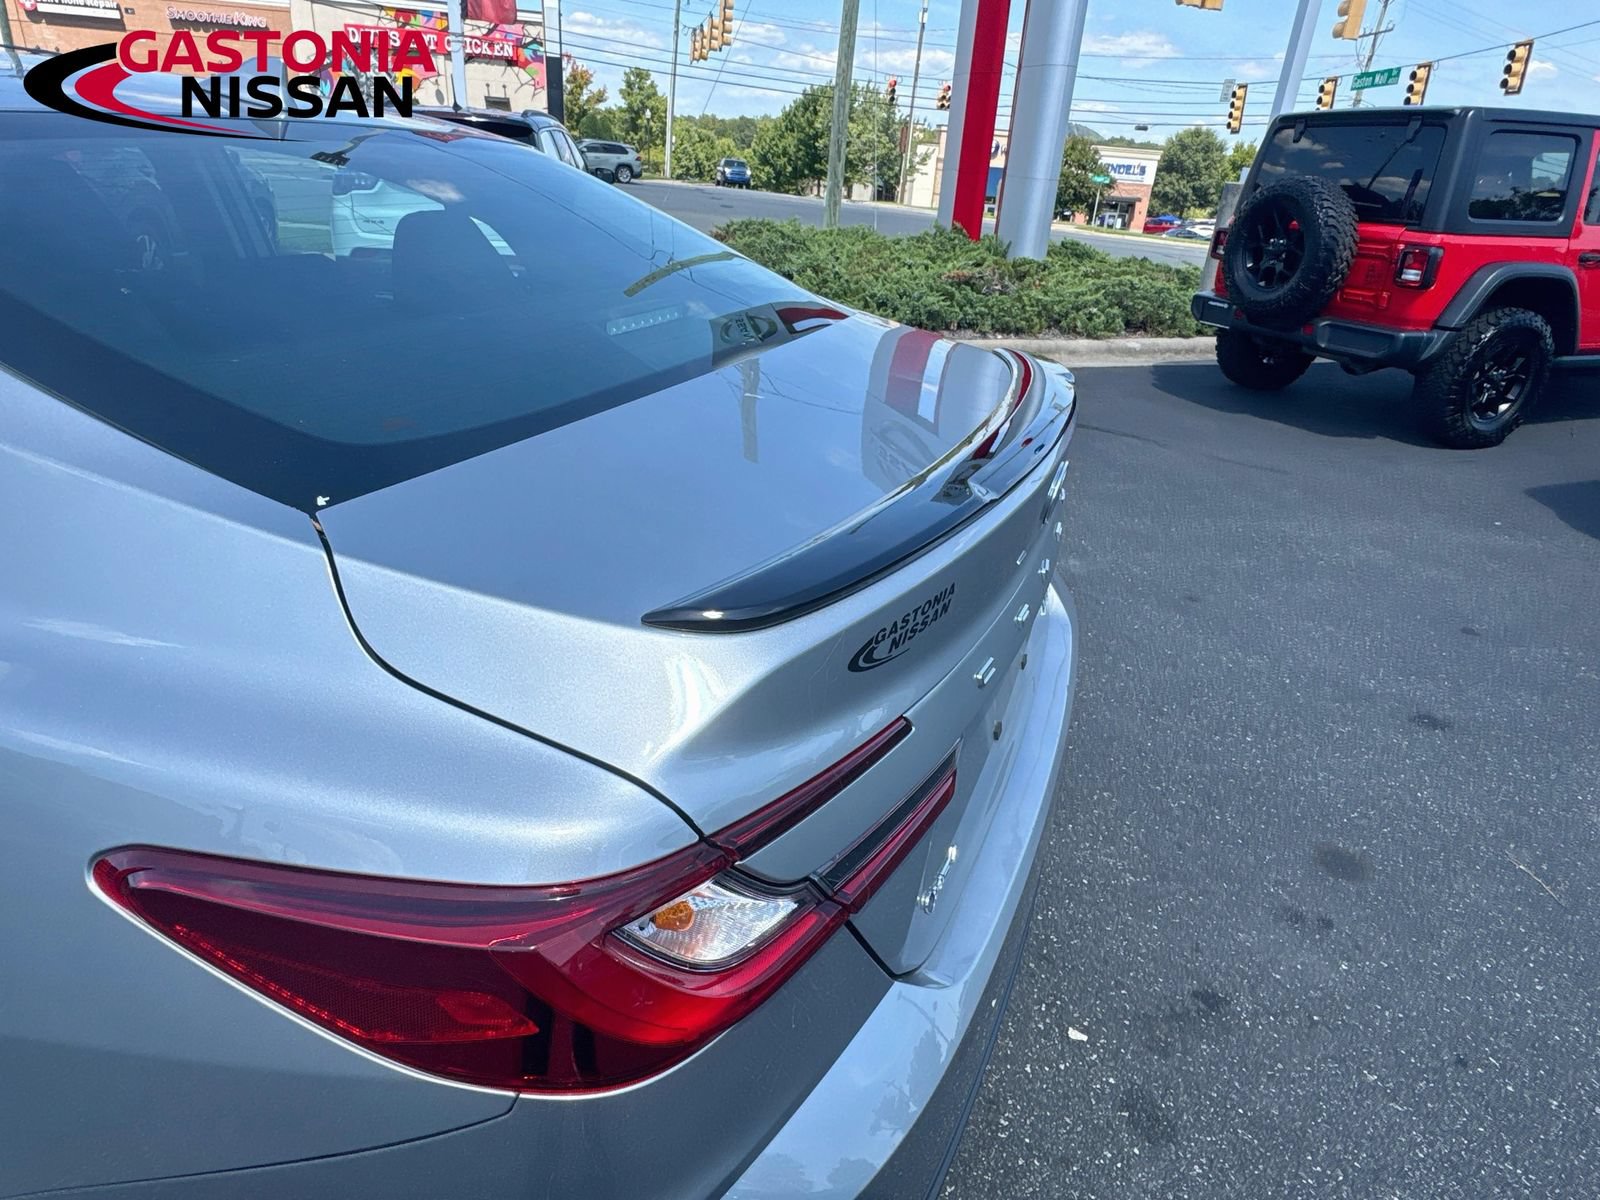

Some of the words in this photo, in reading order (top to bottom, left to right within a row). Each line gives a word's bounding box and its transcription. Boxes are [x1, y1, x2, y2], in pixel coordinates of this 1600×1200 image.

[167, 6, 233, 25] SMOOTHIE
[233, 11, 267, 28] KING
[444, 36, 514, 57] CICKEN
[1352, 76, 1373, 88] Gaston
[1374, 72, 1388, 85] Mall
[874, 582, 955, 645] GASTONIA
[888, 598, 952, 654] NISSAN
